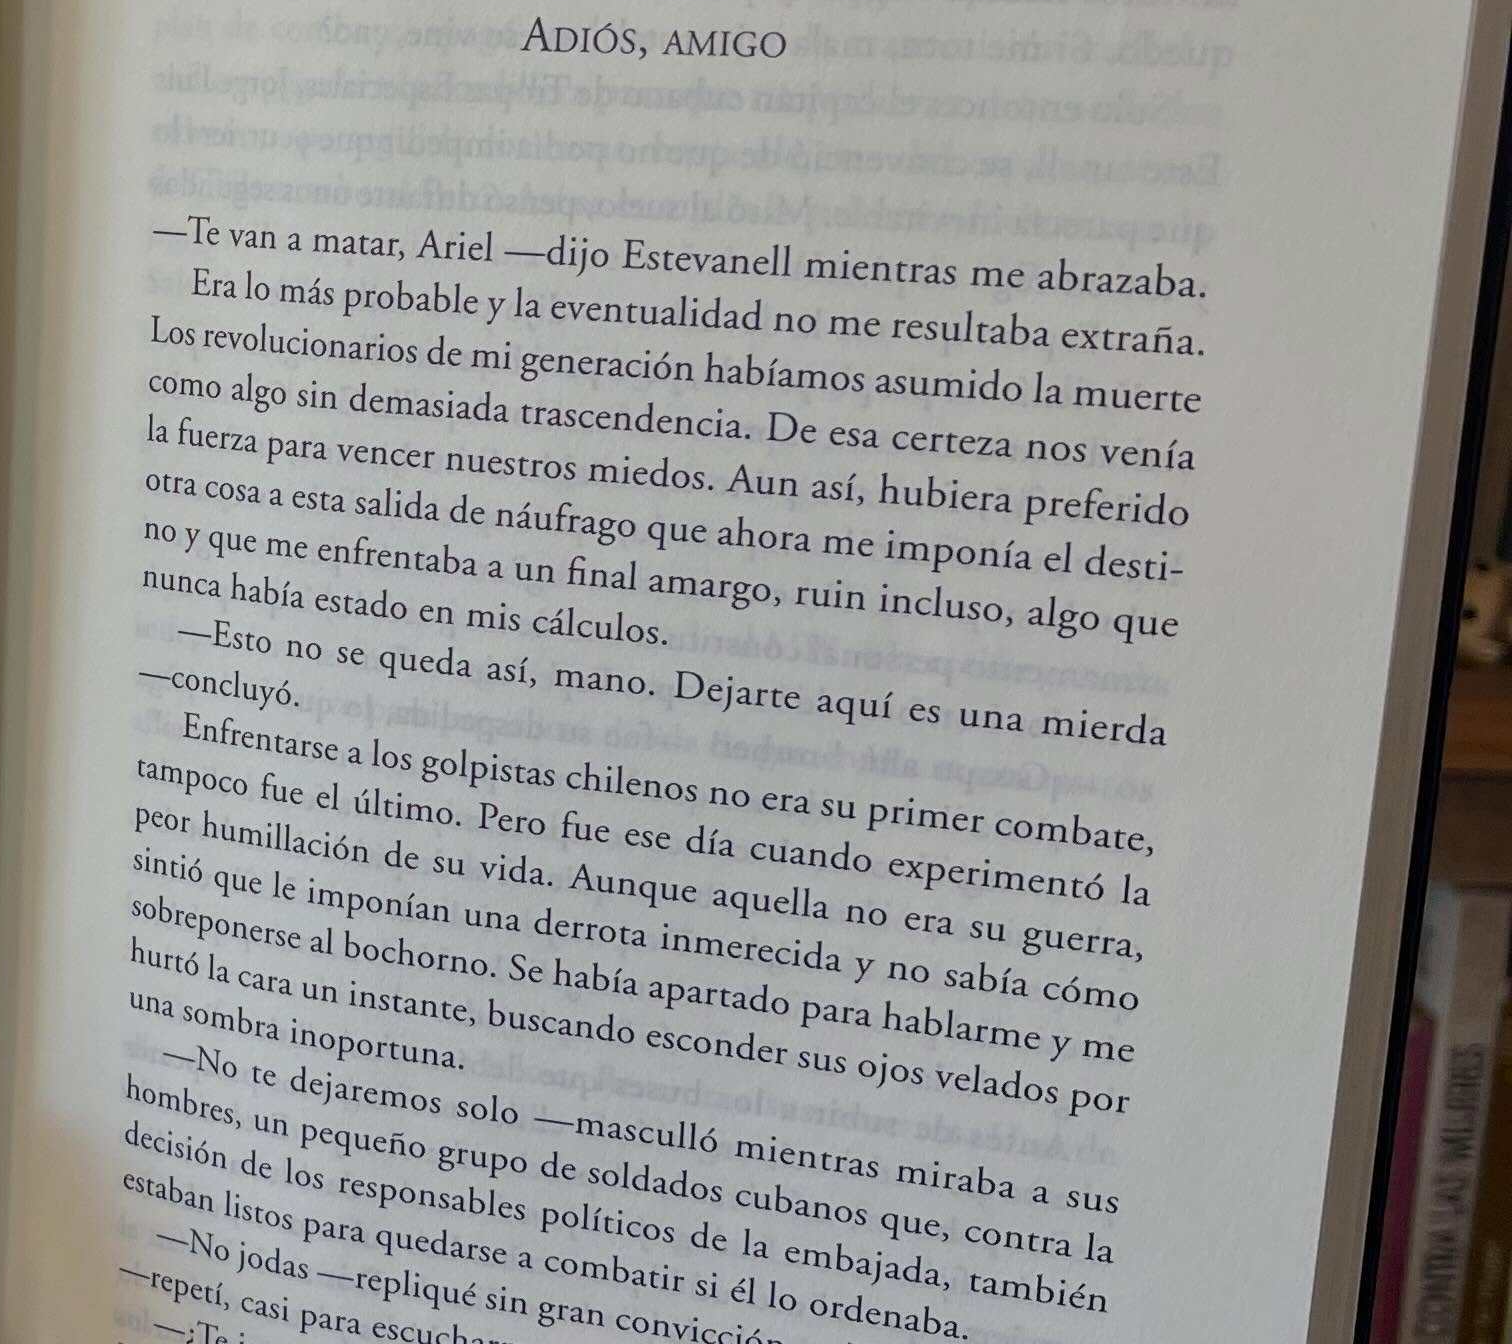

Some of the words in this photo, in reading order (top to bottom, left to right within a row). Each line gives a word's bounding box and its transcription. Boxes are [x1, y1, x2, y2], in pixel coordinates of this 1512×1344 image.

[520, 17, 647, 59] ADIÓS,
[662, 30, 786, 58] AMIGO
[153, 216, 219, 245] —Te
[229, 229, 276, 249] van
[288, 233, 302, 251] a
[313, 234, 404, 261] matar,
[416, 230, 492, 261] Ariel
[504, 234, 608, 276] —dijo
[622, 239, 790, 276] Estevanell
[804, 250, 956, 285] mientras
[971, 267, 1024, 288] me
[1038, 258, 1205, 298] abrazaba.
[143, 571, 221, 597] nunca
[231, 572, 304, 608] había
[315, 589, 407, 619] estado
[420, 605, 454, 624] en
[467, 603, 520, 631] mis
[533, 607, 667, 645] cálculos.
[139, 671, 299, 710] —concluyó.
[130, 992, 174, 1017] una
[183, 1006, 279, 1040] sombra
[291, 1018, 463, 1070] inoportuna.
[125, 1120, 226, 1169] decisión
[241, 1150, 271, 1179] de
[285, 1157, 323, 1189] los
[339, 1177, 525, 1220] responsables
[541, 1203, 674, 1243] políticos
[691, 1222, 727, 1251] de
[743, 1229, 768, 1258] la
[785, 1243, 949, 1291] embajada,
[970, 1274, 1107, 1312] también
[157, 1228, 229, 1261] —No
[237, 1242, 308, 1279] jodas
[317, 1270, 476, 1310] —repliqué
[486, 1287, 527, 1315] sin
[538, 1302, 604, 1327] gran
